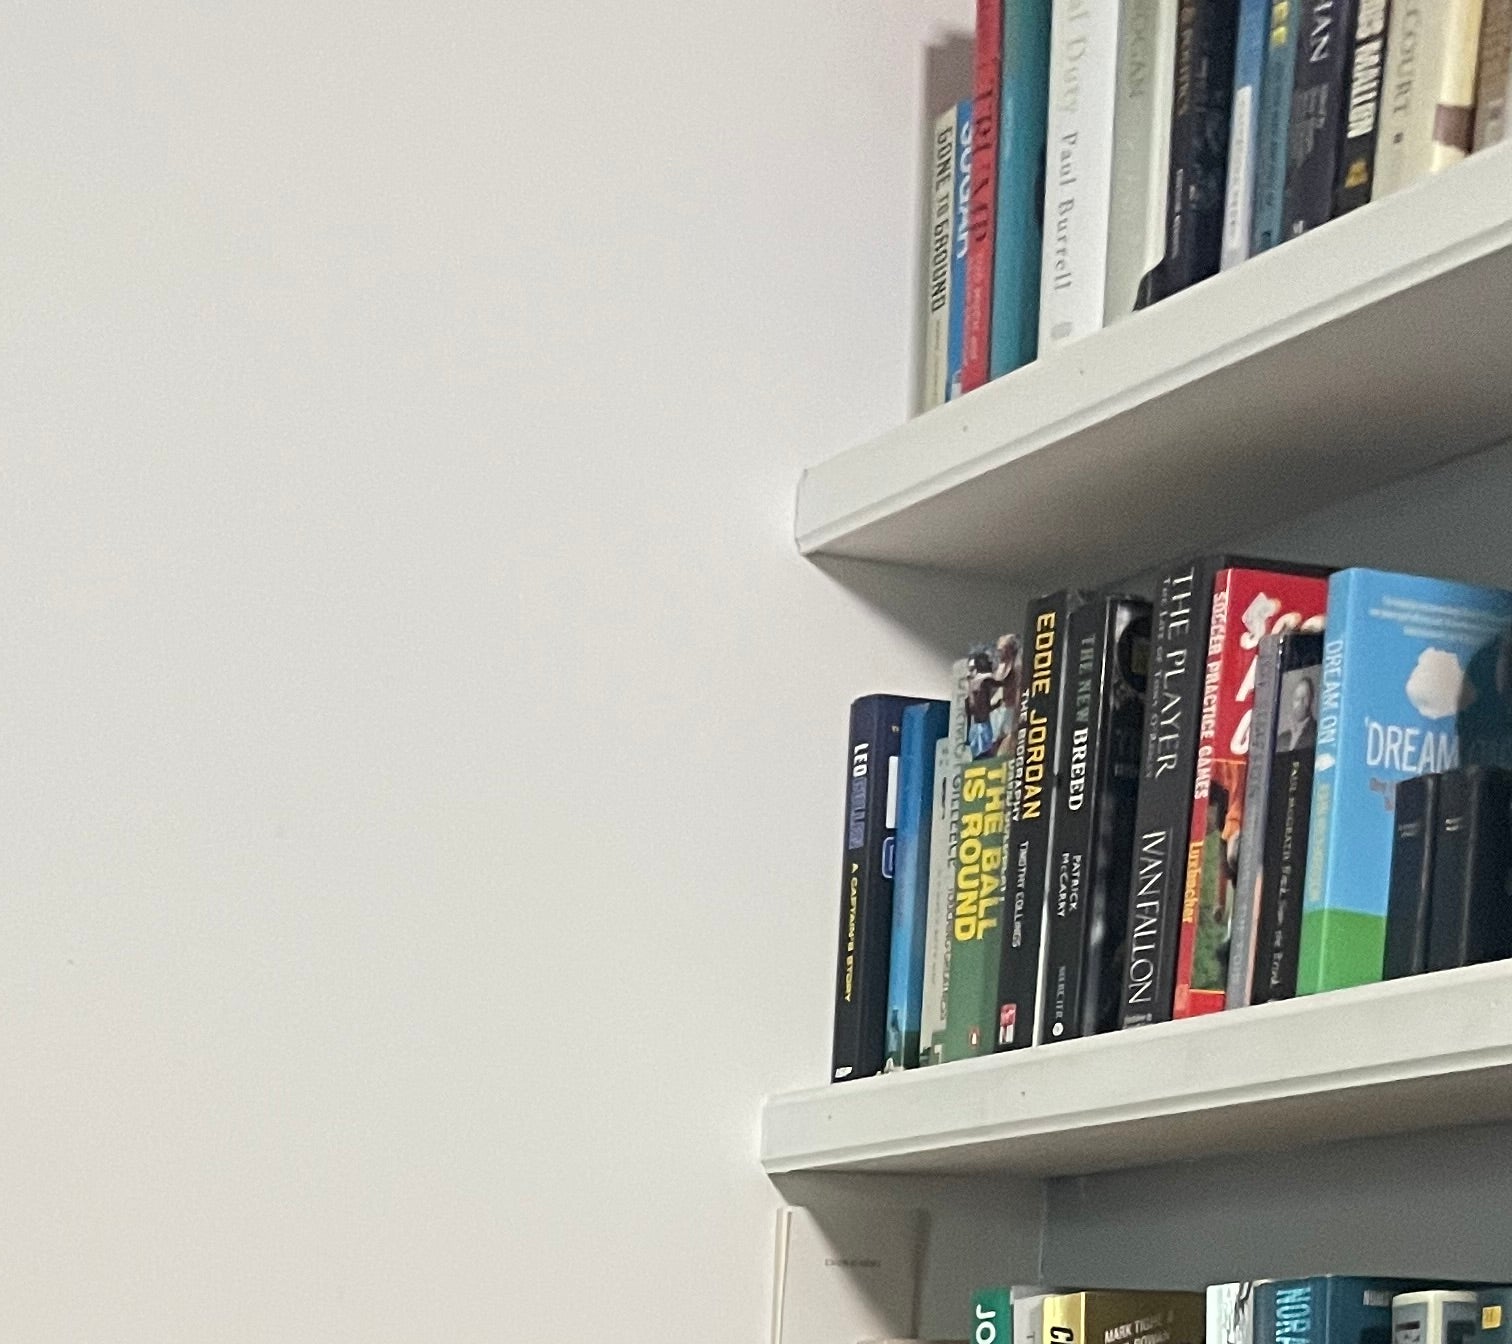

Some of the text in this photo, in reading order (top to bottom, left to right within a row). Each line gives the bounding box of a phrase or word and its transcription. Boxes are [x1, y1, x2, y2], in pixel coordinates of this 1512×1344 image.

[1058, 131, 1080, 191] Paul
[1054, 198, 1077, 292] Burrell
[1021, 611, 1057, 821] EDDIE JORDAN
[1317, 639, 1344, 746] DREAM ON
[1067, 727, 1089, 812] BREED
[1128, 572, 1194, 1006] THE PLAYER IVAN FALLON
[1183, 591, 1228, 925] SOCCER PRACTICE GAMES Luxbacher
[1364, 722, 1461, 775] DREAM
[954, 765, 987, 942] IS ROUND
[976, 763, 1008, 940] THE BALL
[1068, 853, 1083, 913] PATRICK
